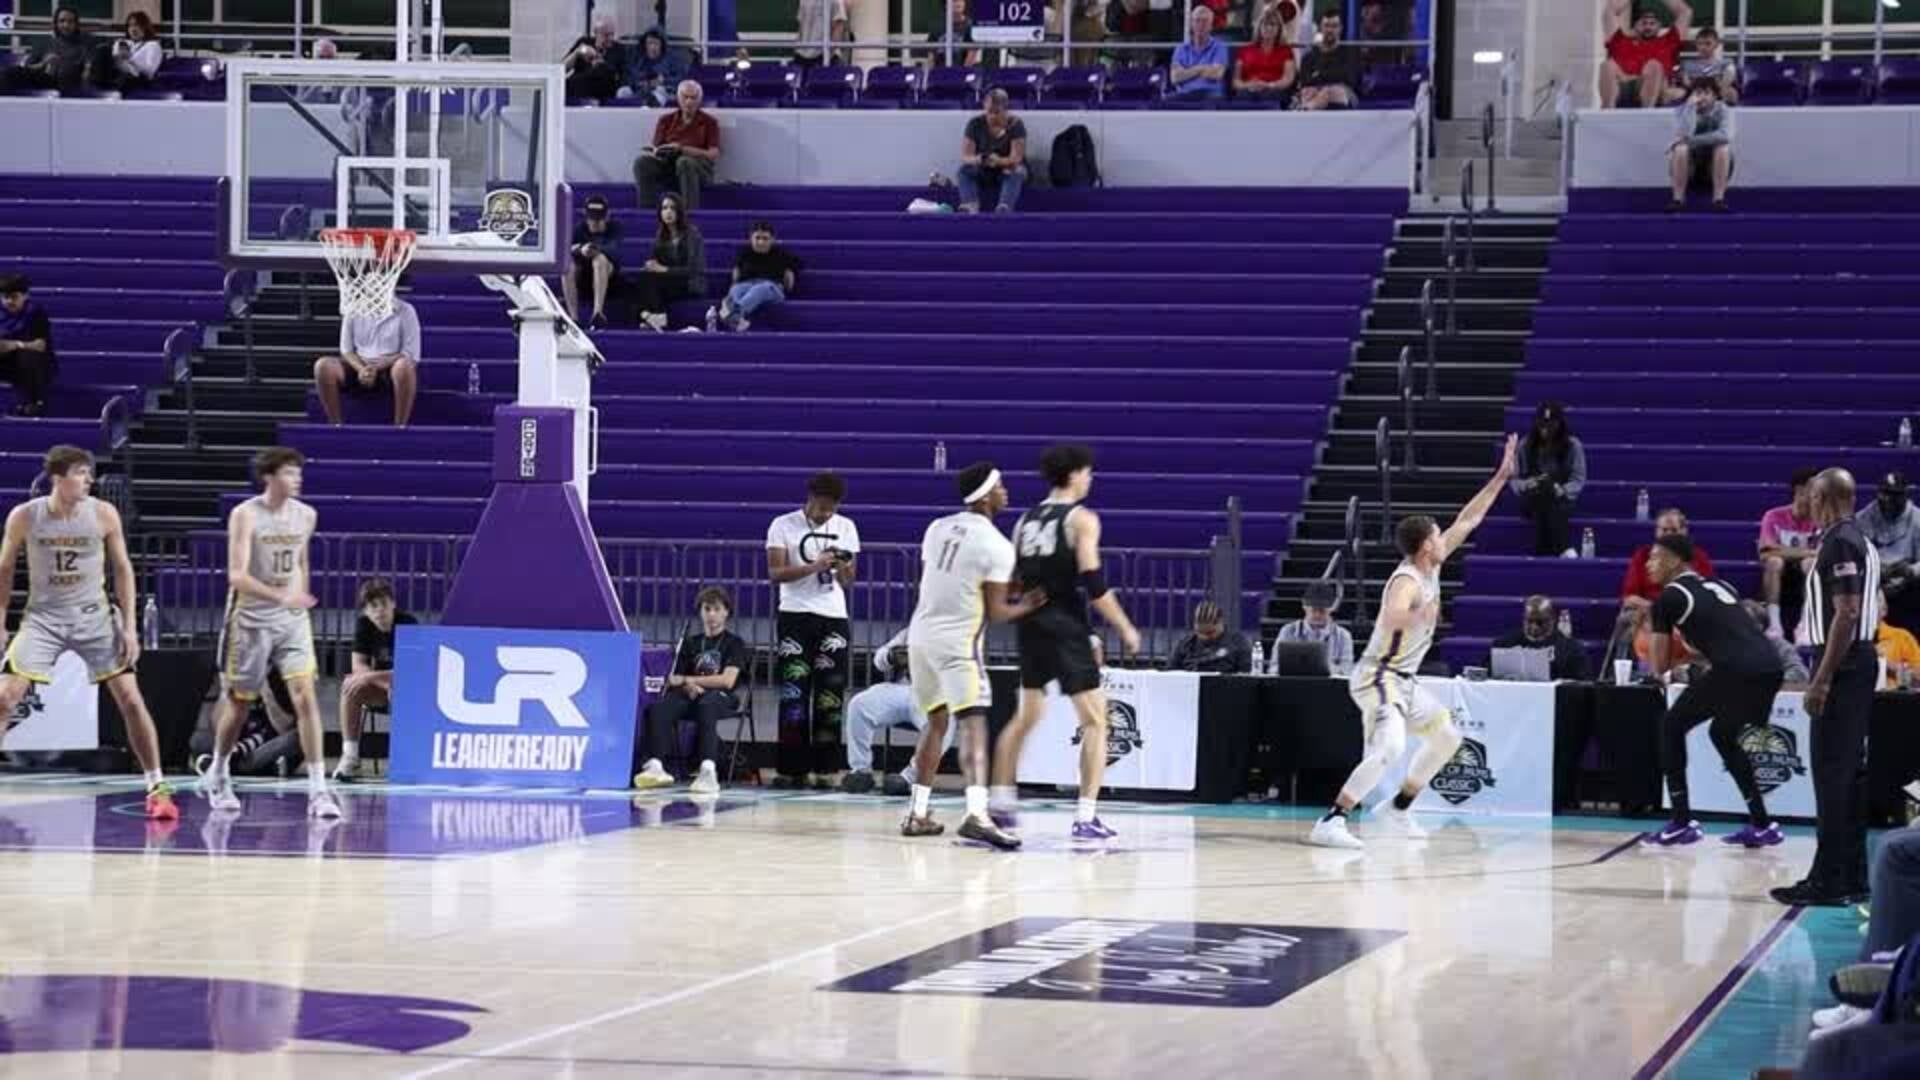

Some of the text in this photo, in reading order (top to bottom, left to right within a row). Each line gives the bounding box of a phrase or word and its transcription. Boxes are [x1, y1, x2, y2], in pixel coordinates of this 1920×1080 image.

[999, 2, 1031, 20] 102
[1020, 518, 1059, 557] 24
[56, 550, 79, 572] 12
[272, 549, 293, 573] 10
[937, 540, 960, 572] 11
[432, 732, 590, 771] LEAGUEREADY
